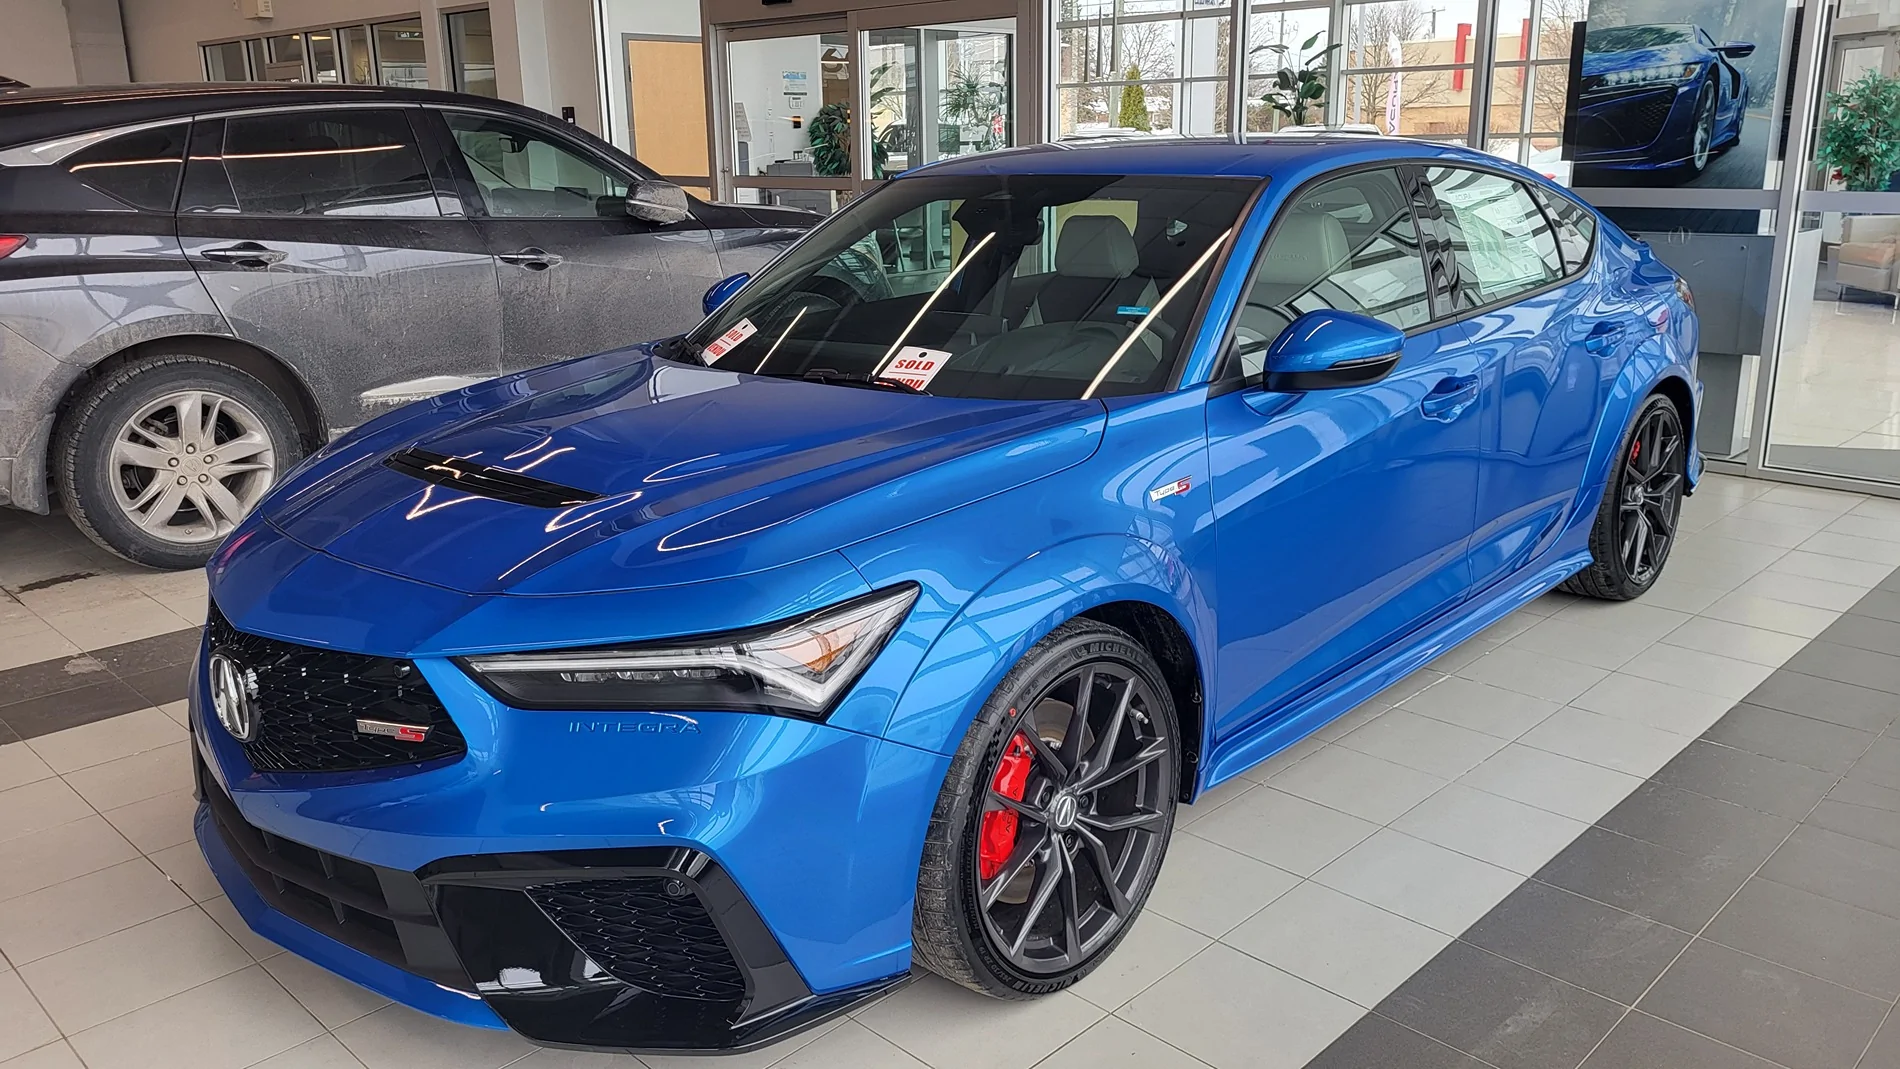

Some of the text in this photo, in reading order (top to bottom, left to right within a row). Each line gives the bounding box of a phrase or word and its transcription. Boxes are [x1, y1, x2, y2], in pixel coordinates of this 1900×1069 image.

[726, 329, 743, 341] SOLD
[895, 359, 935, 371] SOLD
[1175, 479, 1192, 495] S
[1089, 642, 1144, 664] MICHELIN
[361, 723, 427, 743] Type S
[569, 721, 701, 734] INTEGRA
[1012, 976, 1074, 994] MICHELIN
